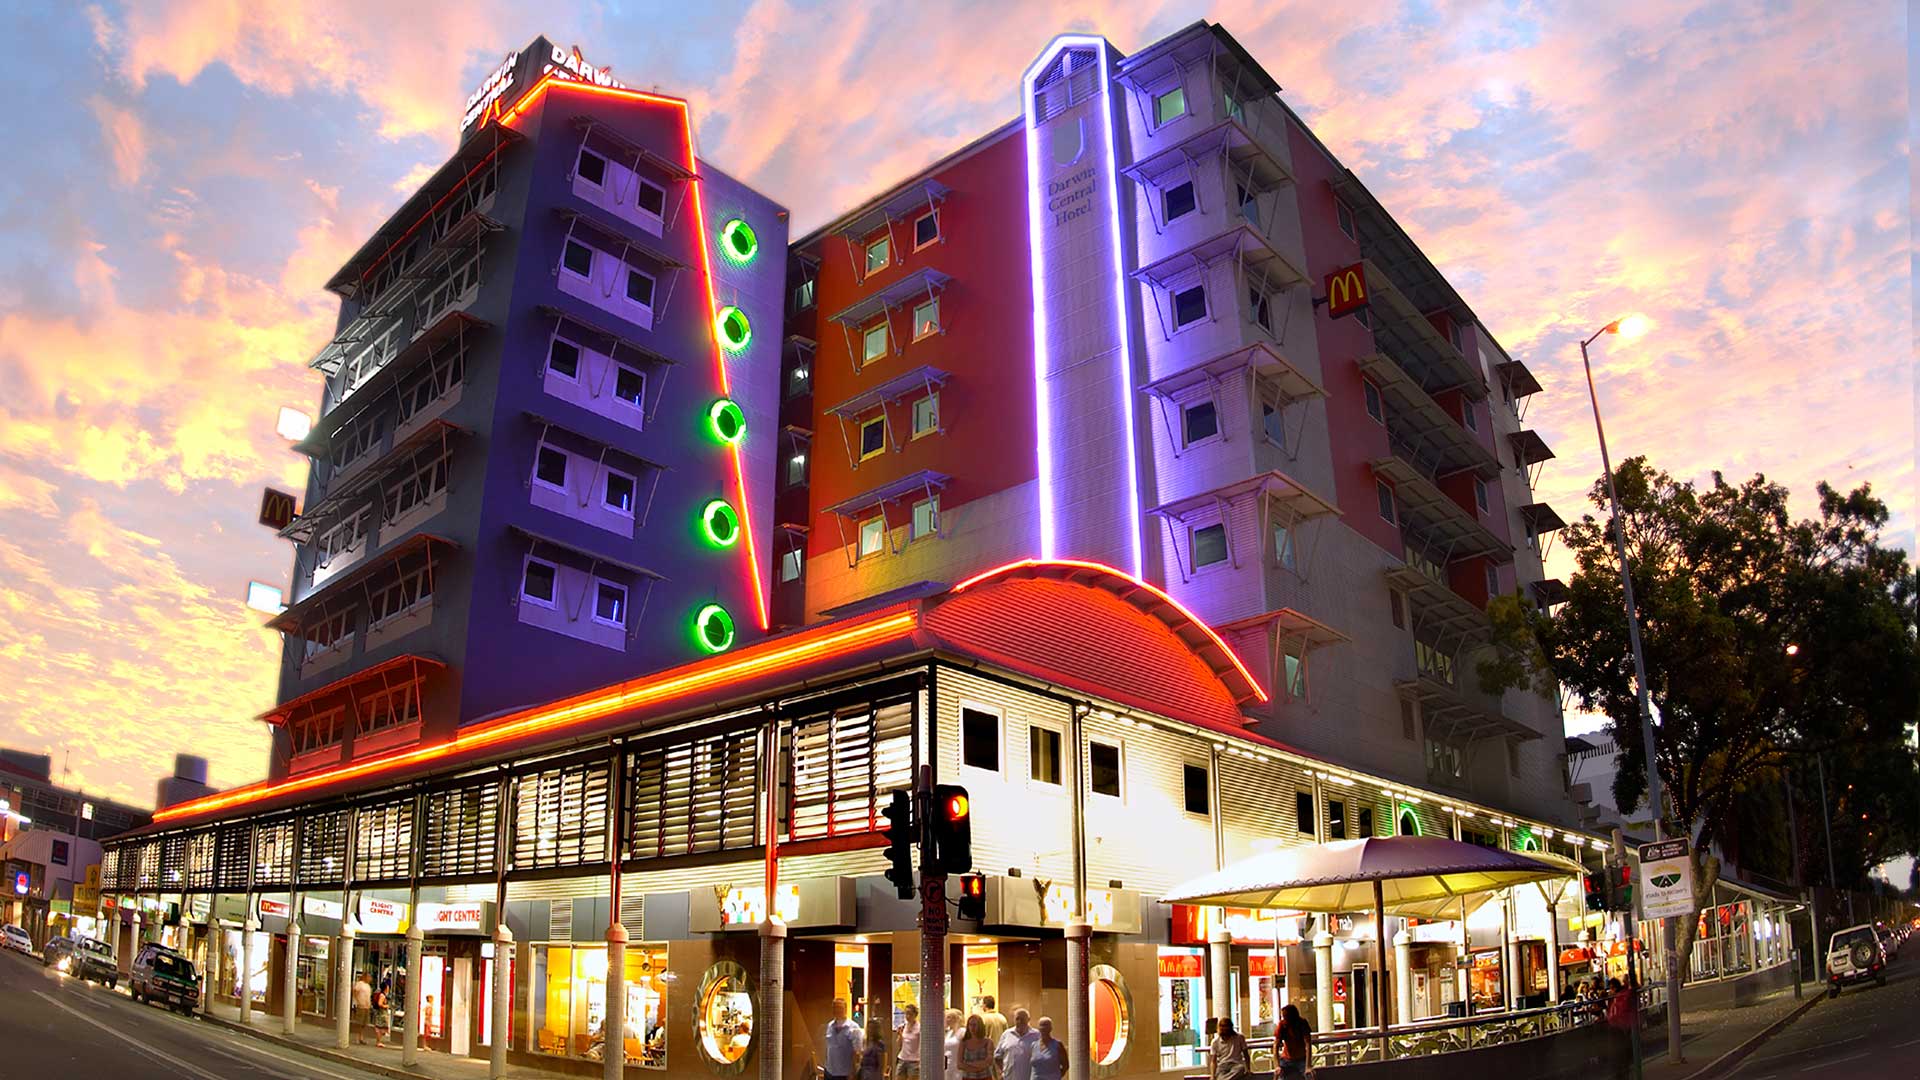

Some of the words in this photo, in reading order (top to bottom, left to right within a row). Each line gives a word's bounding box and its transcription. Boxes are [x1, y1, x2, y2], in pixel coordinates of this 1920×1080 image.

[1048, 167, 1096, 196] Darwin
[1048, 180, 1096, 212] Central
[1054, 197, 1092, 227] Hotel
[453, 909, 481, 922] CENTRE
[1339, 914, 1353, 931] nab
